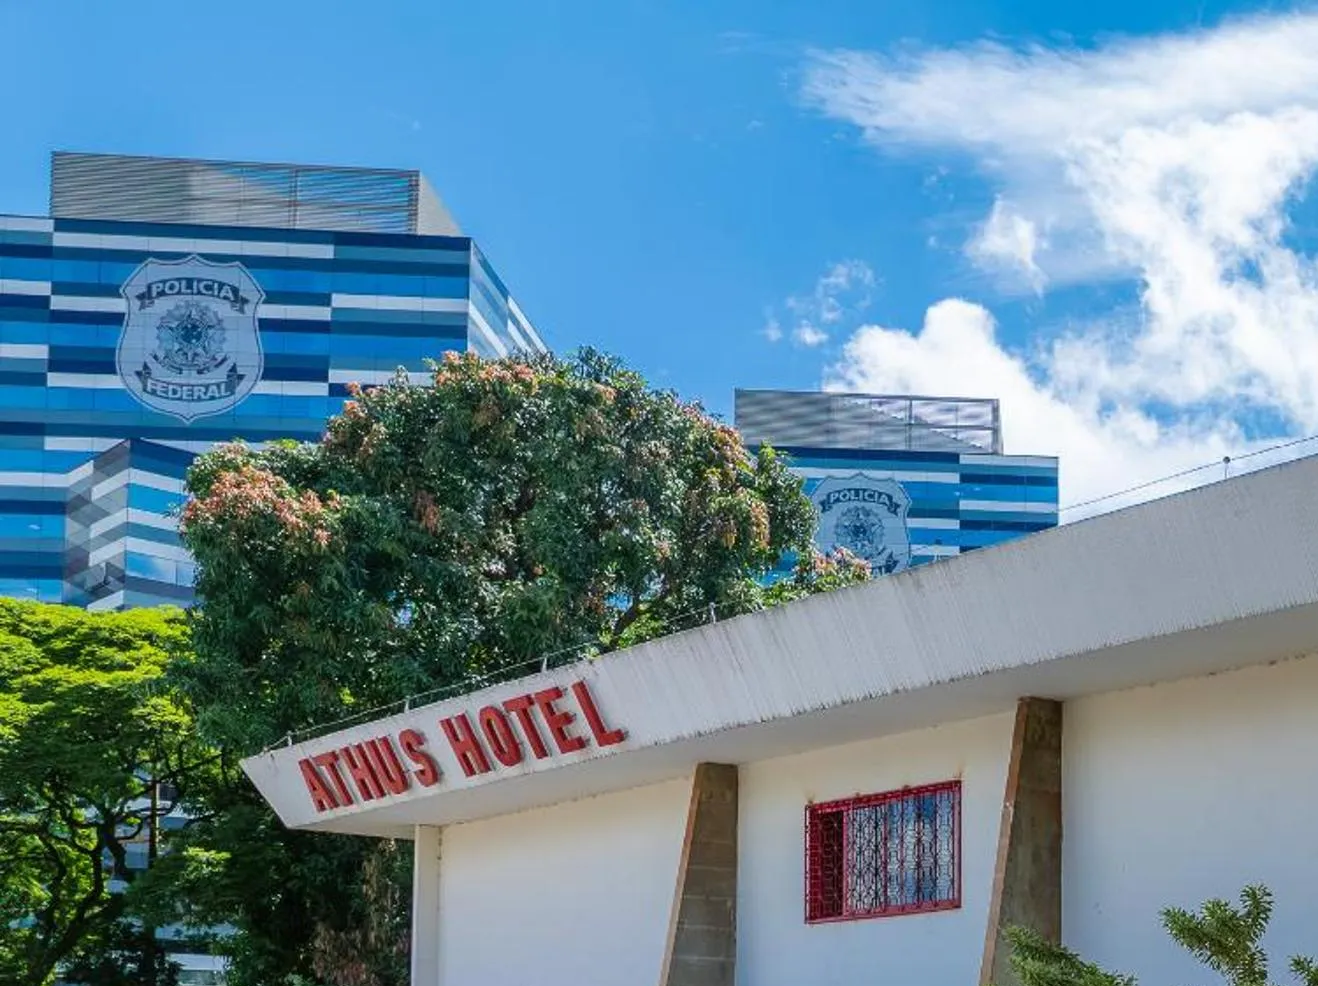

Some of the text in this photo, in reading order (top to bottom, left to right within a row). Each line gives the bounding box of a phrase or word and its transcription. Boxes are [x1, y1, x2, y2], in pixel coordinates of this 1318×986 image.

[147, 381, 231, 400] FEDERAL
[298, 680, 627, 812] ATHUS HOTEL
